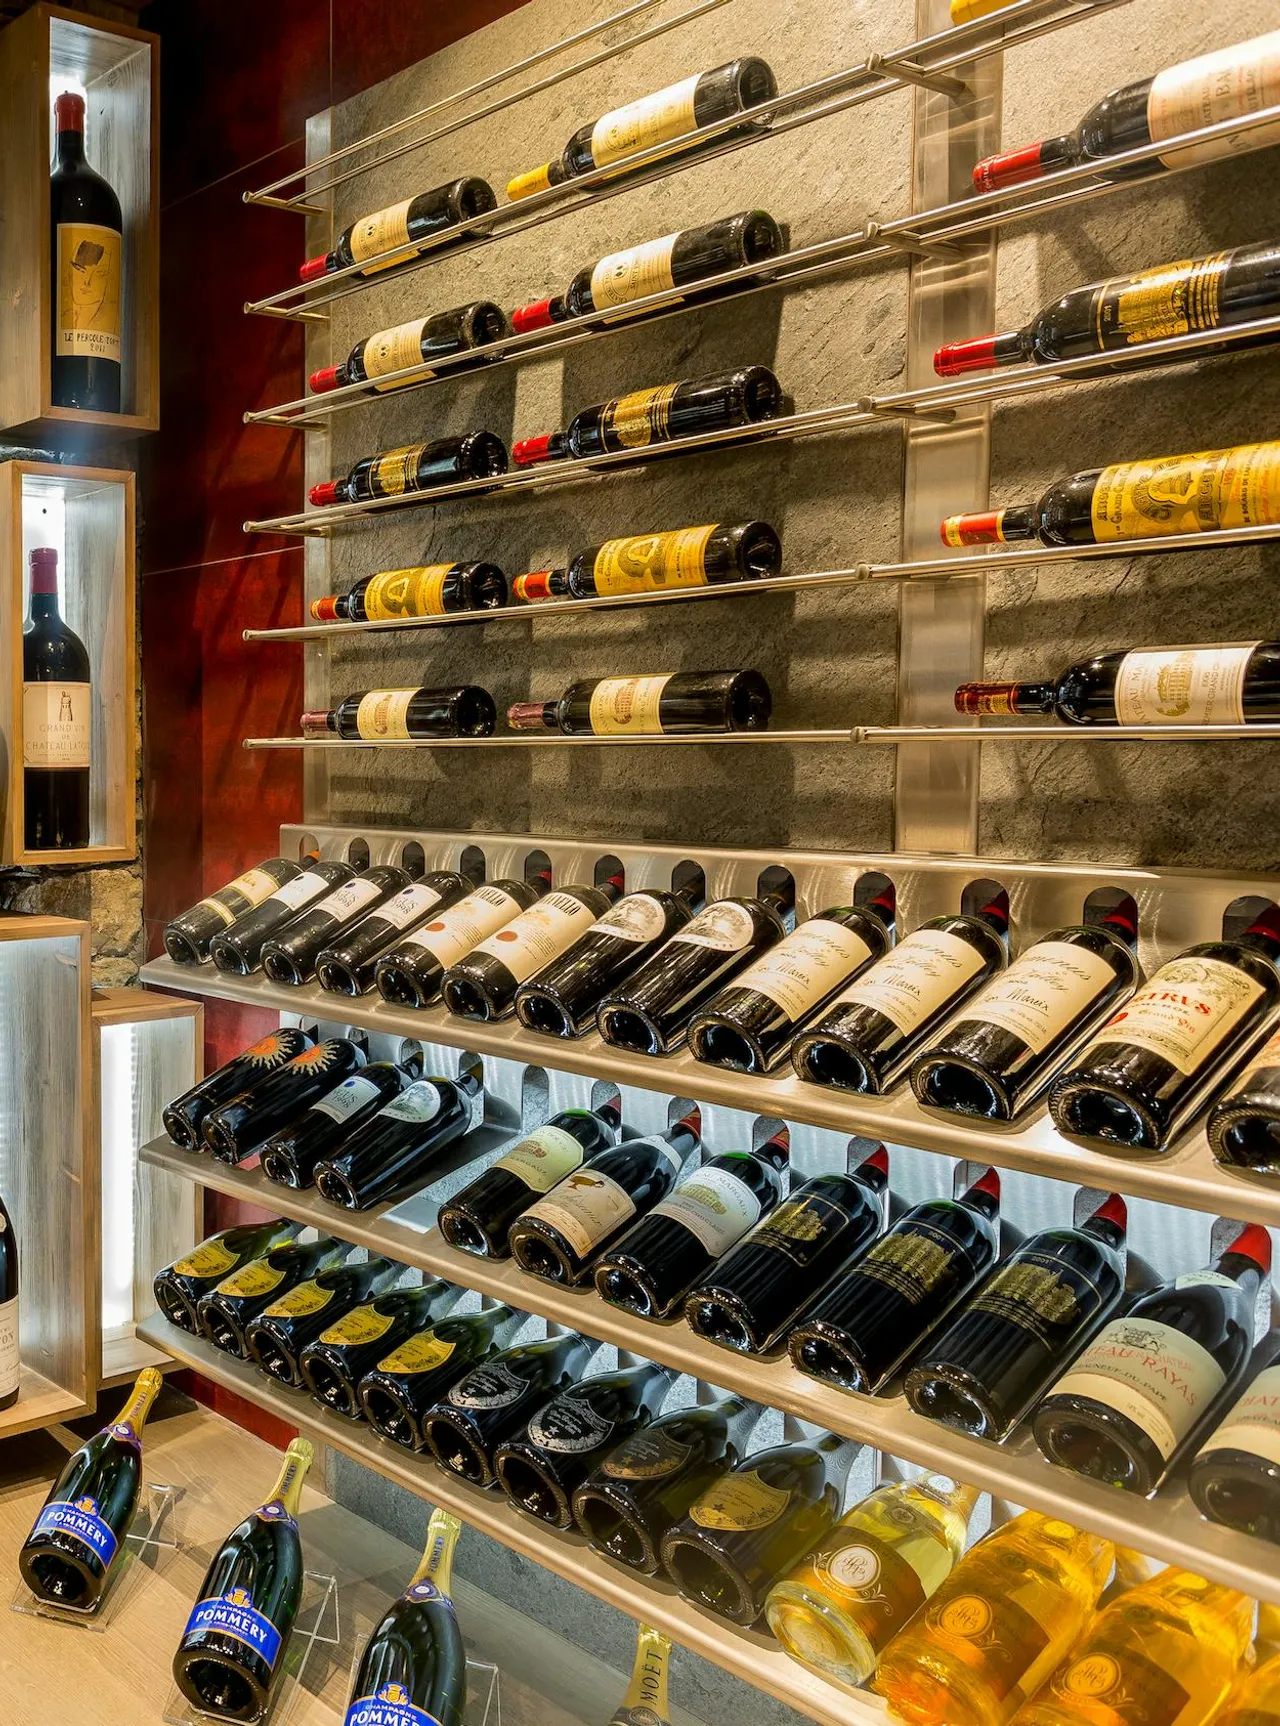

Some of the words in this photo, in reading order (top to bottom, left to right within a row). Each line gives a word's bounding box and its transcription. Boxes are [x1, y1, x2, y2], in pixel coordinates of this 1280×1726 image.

[1142, 1356, 1197, 1406] RAYAS
[47, 1511, 108, 1548] POMMERY
[195, 1608, 268, 1644] POMMERY
[212, 1604, 257, 1624] CHAMPAGNE
[639, 1648, 664, 1706] MOËT
[365, 1704, 418, 1722] CHAMPAGNE
